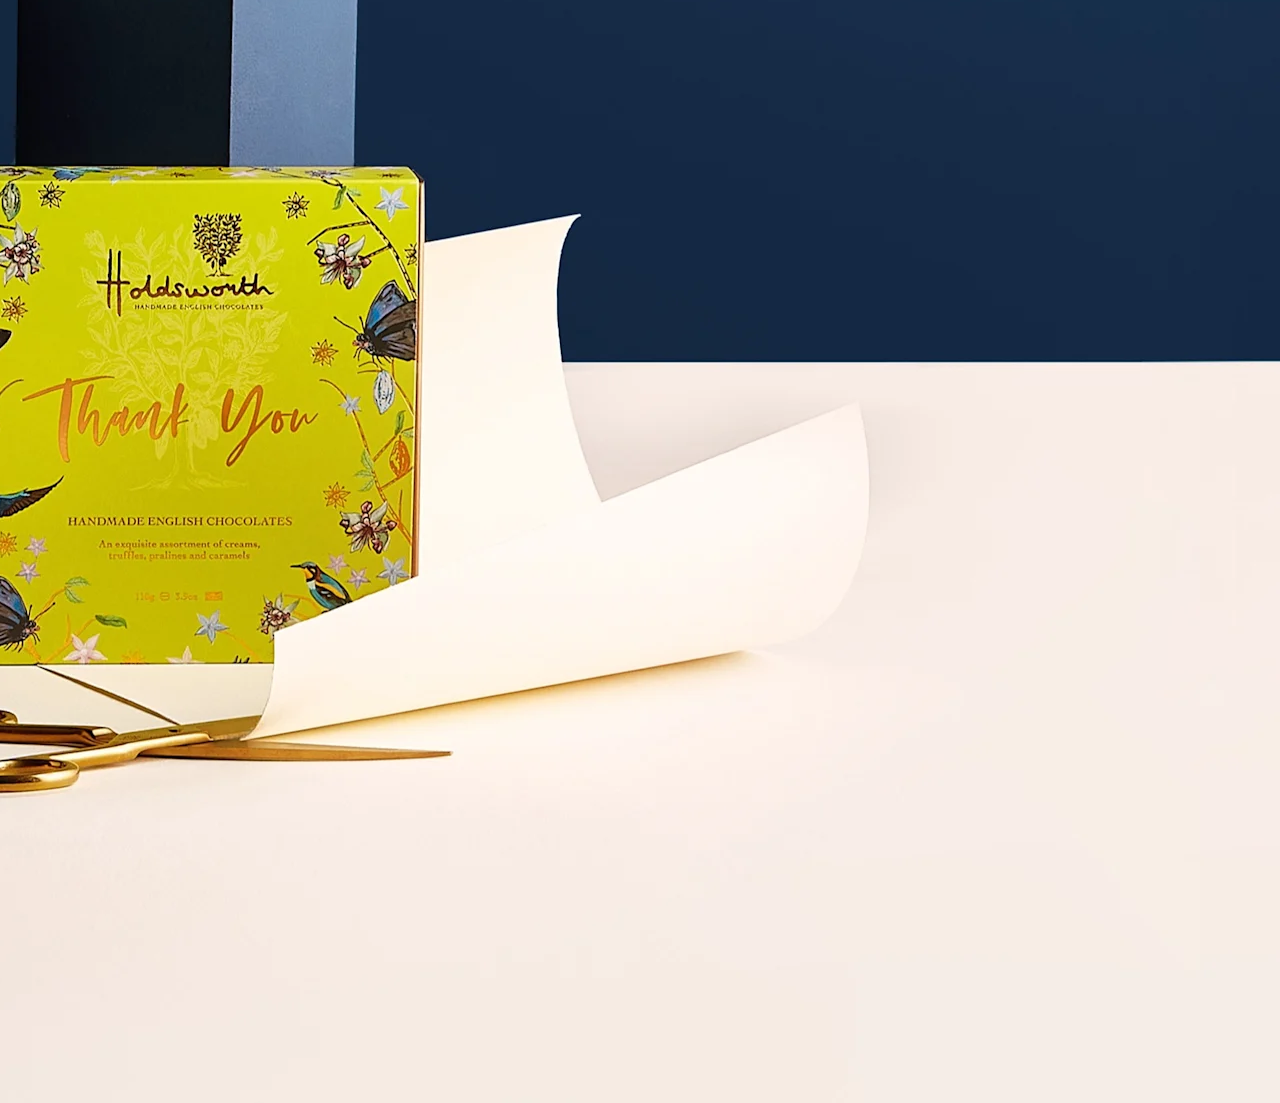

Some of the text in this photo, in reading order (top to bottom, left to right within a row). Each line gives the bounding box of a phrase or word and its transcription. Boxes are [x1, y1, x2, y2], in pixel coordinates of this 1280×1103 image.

[96, 248, 274, 317] Holdsworth
[22, 375, 319, 468] Thank You
[68, 516, 293, 527] HANDMADE ENGLISH CHOCOLATES
[99, 539, 261, 551] An exquisite assortment of creams,
[108, 551, 251, 562] truffles, pralines and caramels
